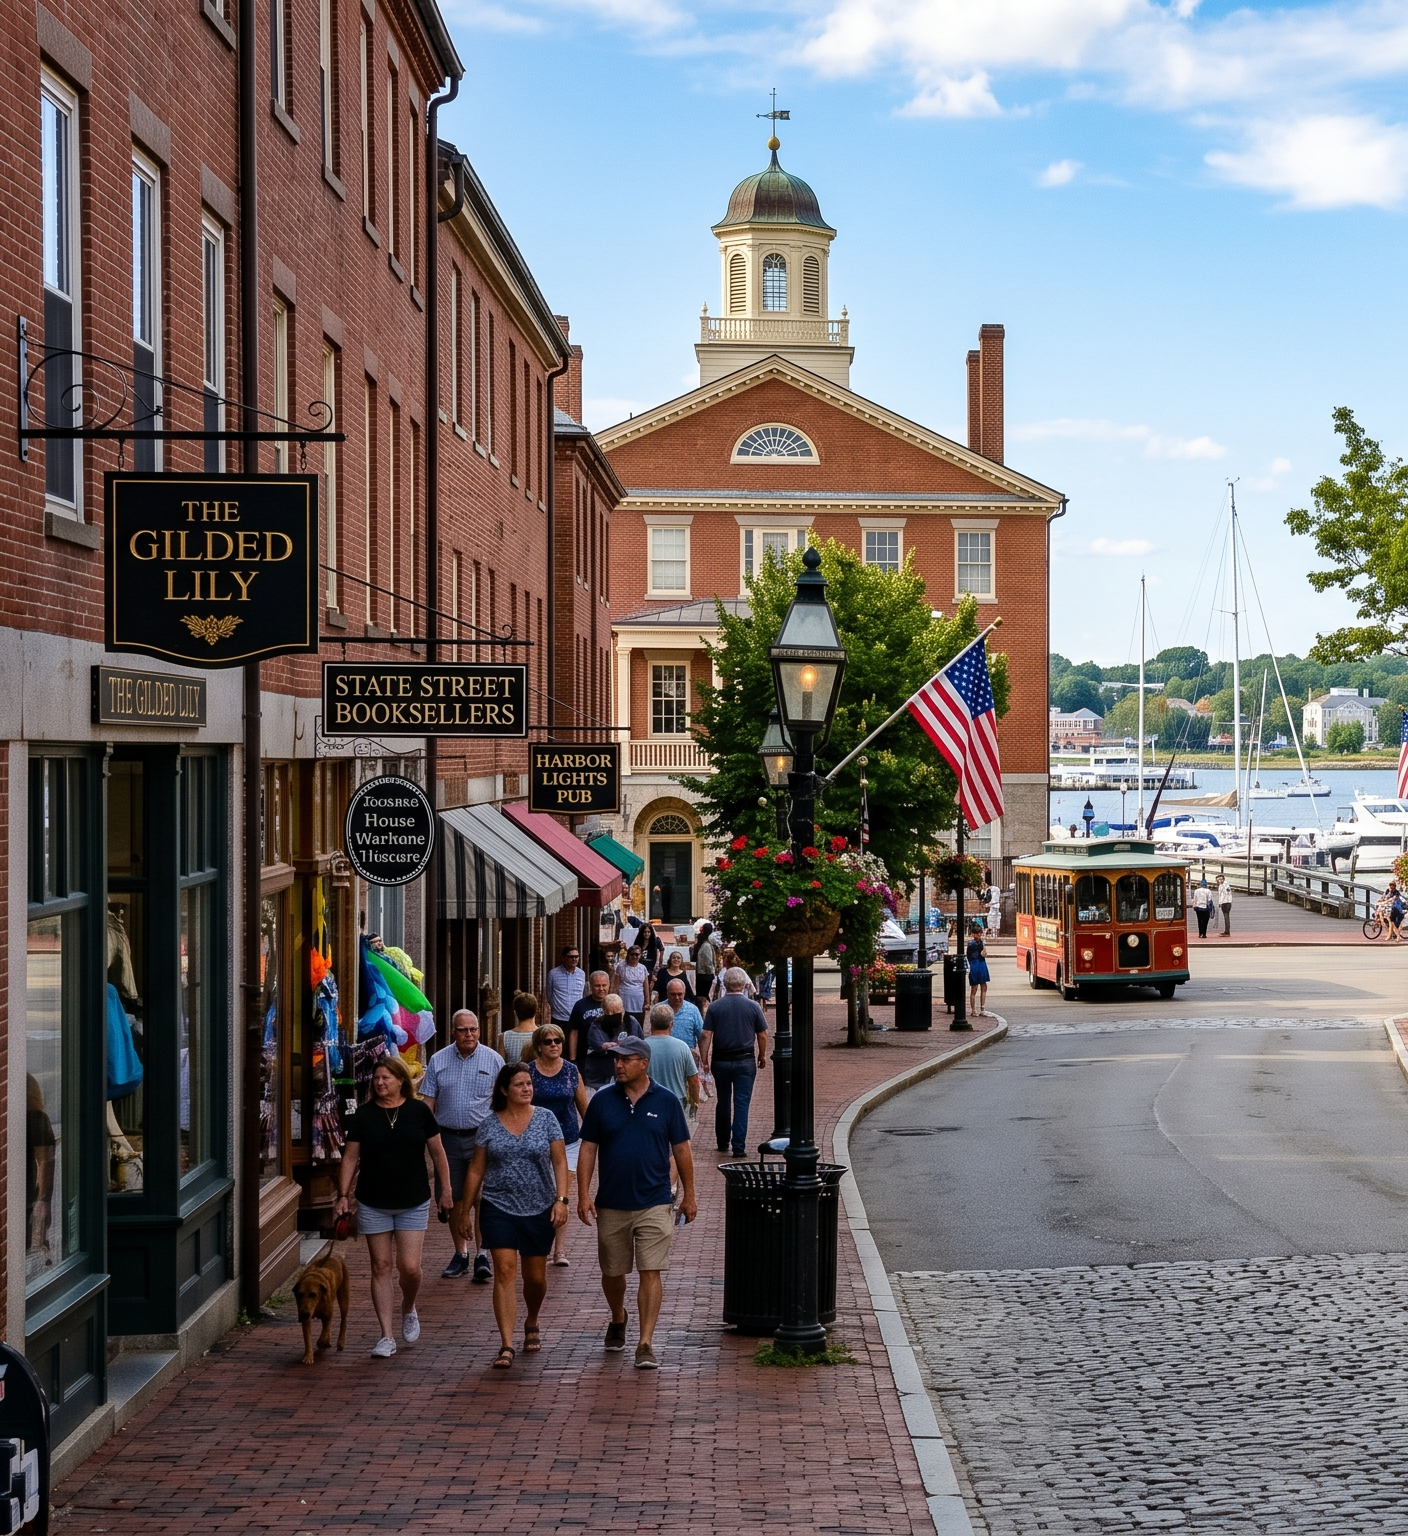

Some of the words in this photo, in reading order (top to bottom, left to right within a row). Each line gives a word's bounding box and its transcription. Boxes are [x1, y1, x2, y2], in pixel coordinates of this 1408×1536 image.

[181, 501, 240, 522] THE
[129, 529, 293, 561] GILDED
[163, 570, 260, 601] LILY
[108, 676, 133, 714] THE
[135, 679, 177, 717] GILDED
[179, 684, 200, 718] LILY
[335, 675, 413, 697] STATE
[420, 676, 516, 698] STREET
[335, 702, 515, 725] BOOKSELLERS
[536, 754, 613, 768] HARBOR
[542, 772, 608, 786] LIGHTS
[556, 789, 592, 803] PUB
[364, 813, 416, 827] House
